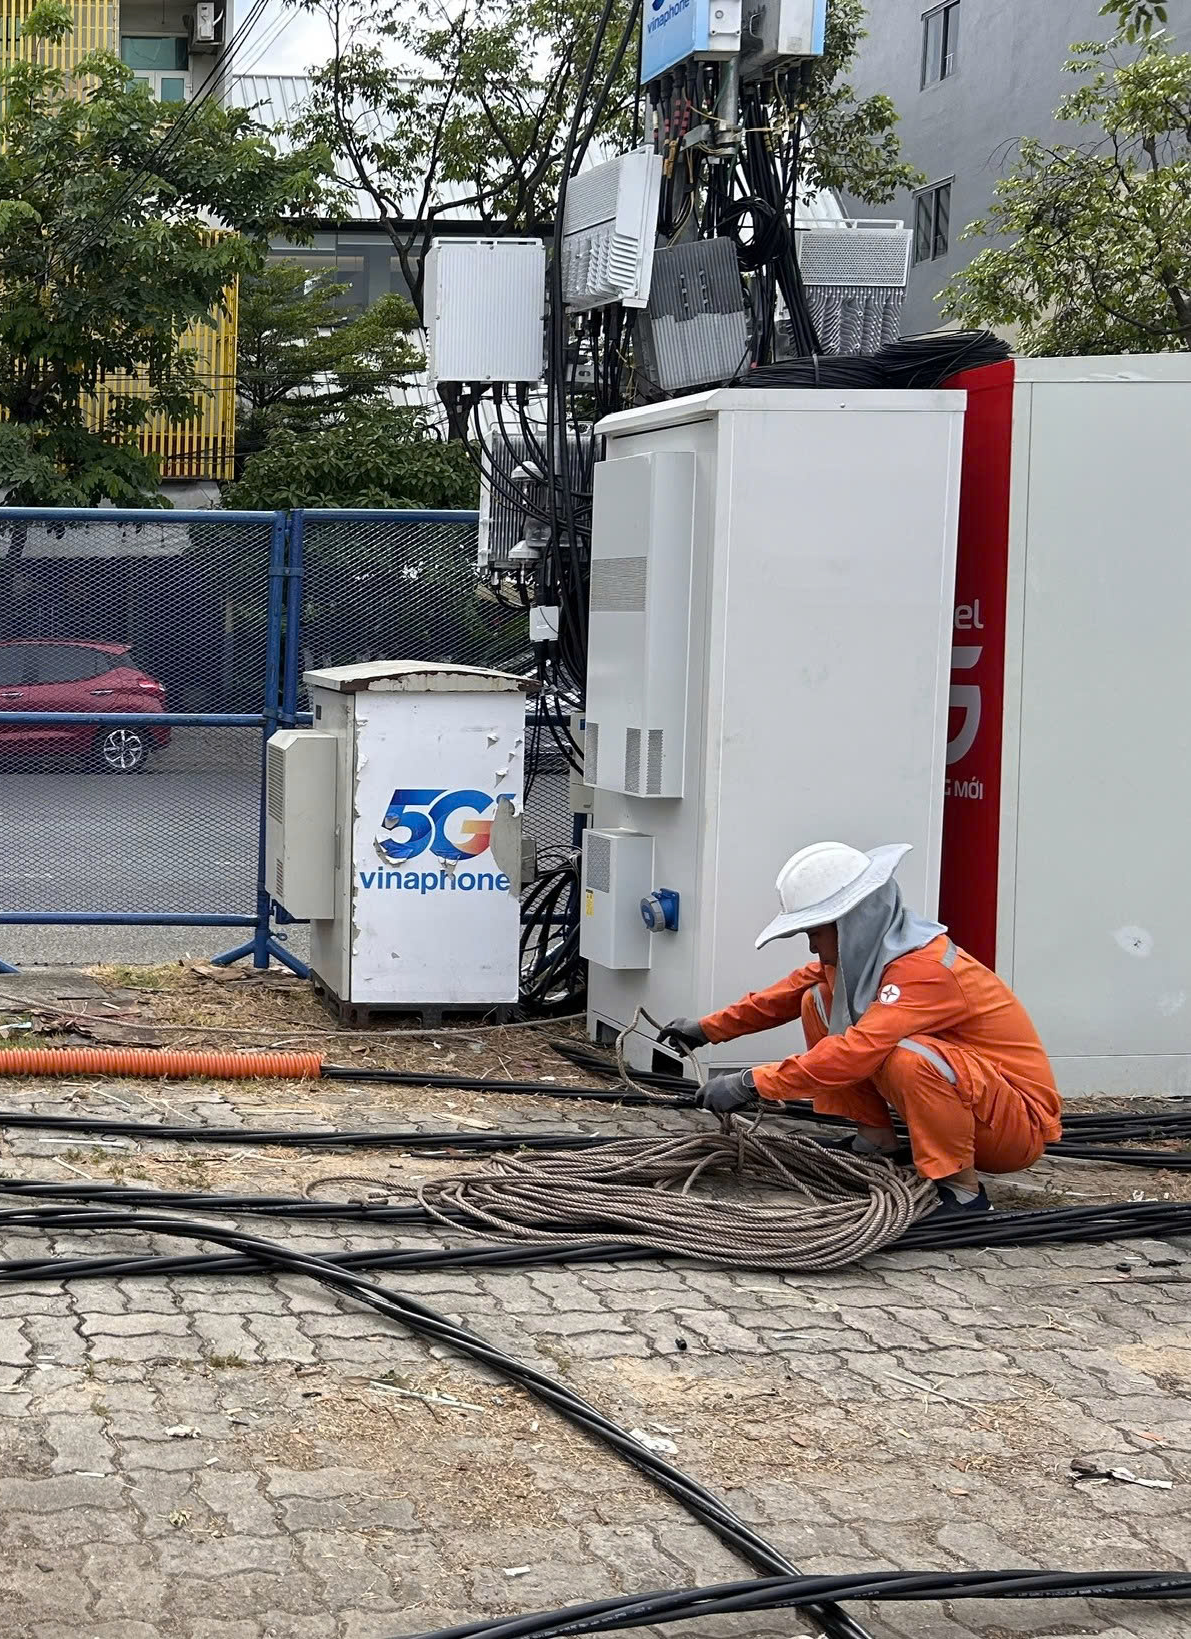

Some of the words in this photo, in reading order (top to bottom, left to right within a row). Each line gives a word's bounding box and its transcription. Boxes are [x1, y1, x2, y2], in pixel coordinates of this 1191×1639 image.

[647, 0, 690, 34] vinaphone
[953, 776, 984, 800] MỚI
[379, 788, 495, 861] 5G
[359, 866, 511, 895] vinaphone
